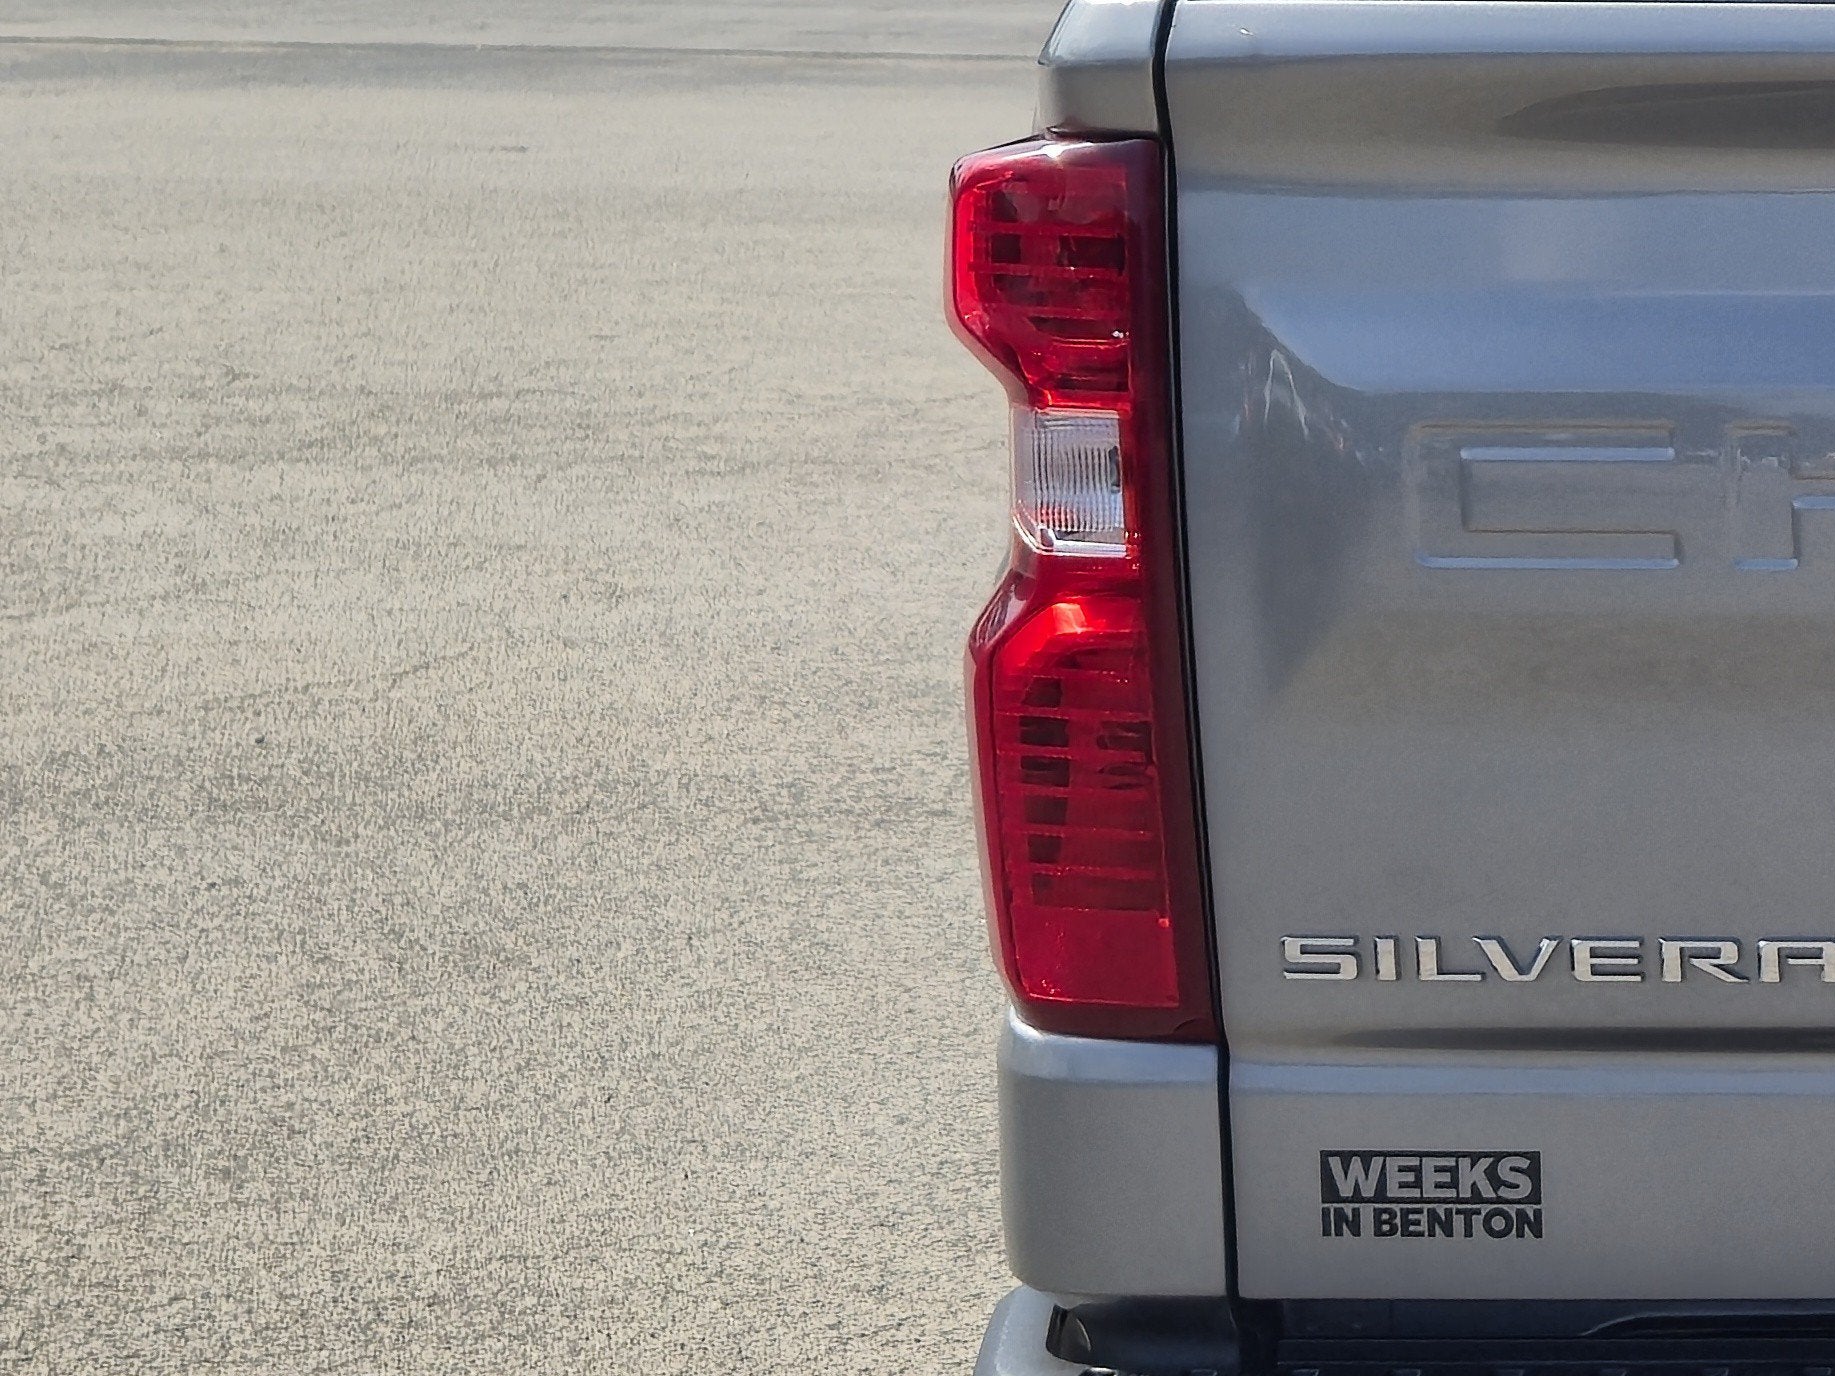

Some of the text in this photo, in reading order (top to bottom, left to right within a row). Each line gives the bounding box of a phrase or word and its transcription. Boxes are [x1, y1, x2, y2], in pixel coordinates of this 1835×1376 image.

[1328, 1156, 1532, 1199] WEEKS
[1321, 1207, 1543, 1238] IN BENTON
